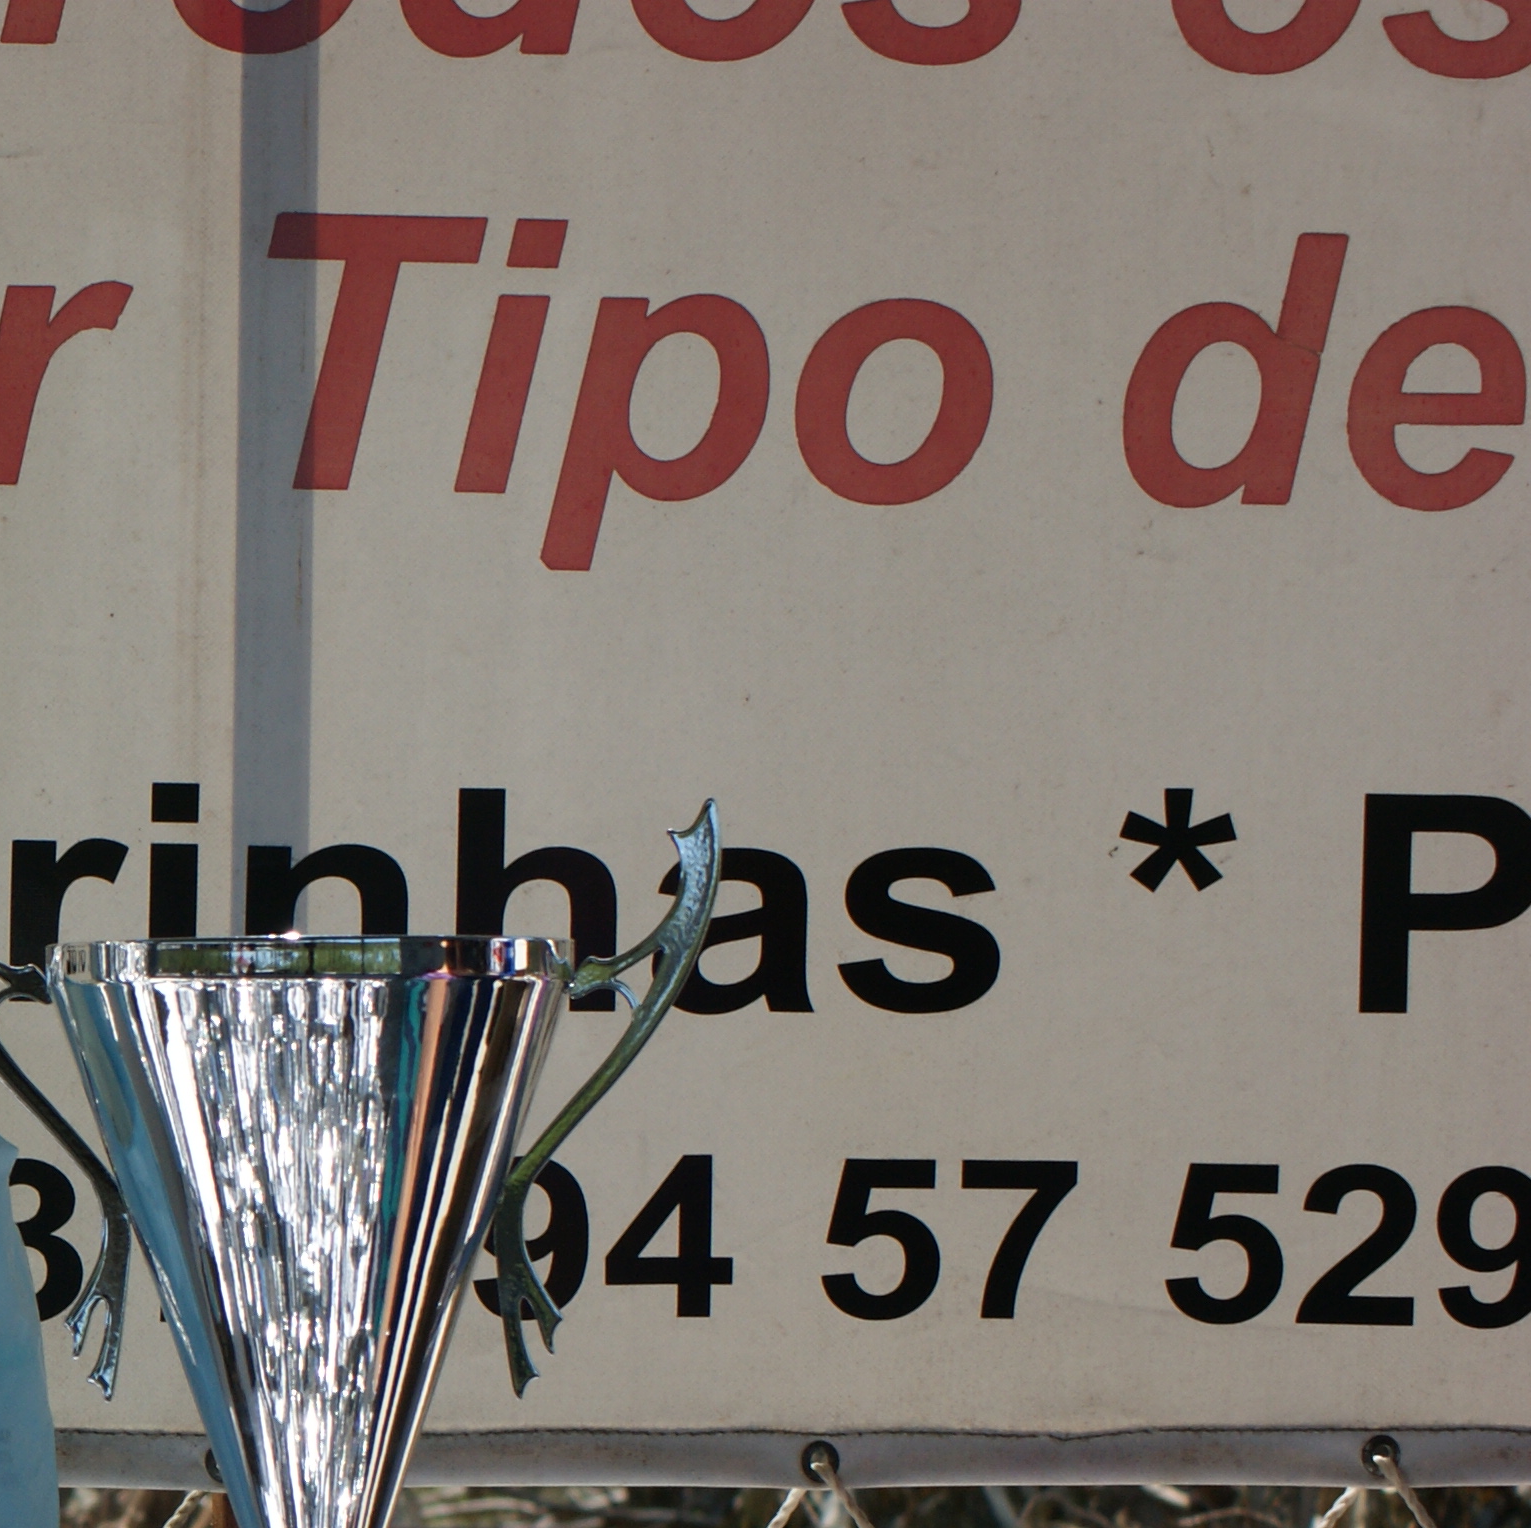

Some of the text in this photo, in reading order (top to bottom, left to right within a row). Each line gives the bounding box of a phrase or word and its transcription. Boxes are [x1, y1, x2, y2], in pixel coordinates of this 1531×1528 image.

[268, 212, 993, 572] Tipo
[1121, 233, 1527, 512] de
[473, 1154, 733, 1321] 94
[821, 1158, 1078, 1321] 57
